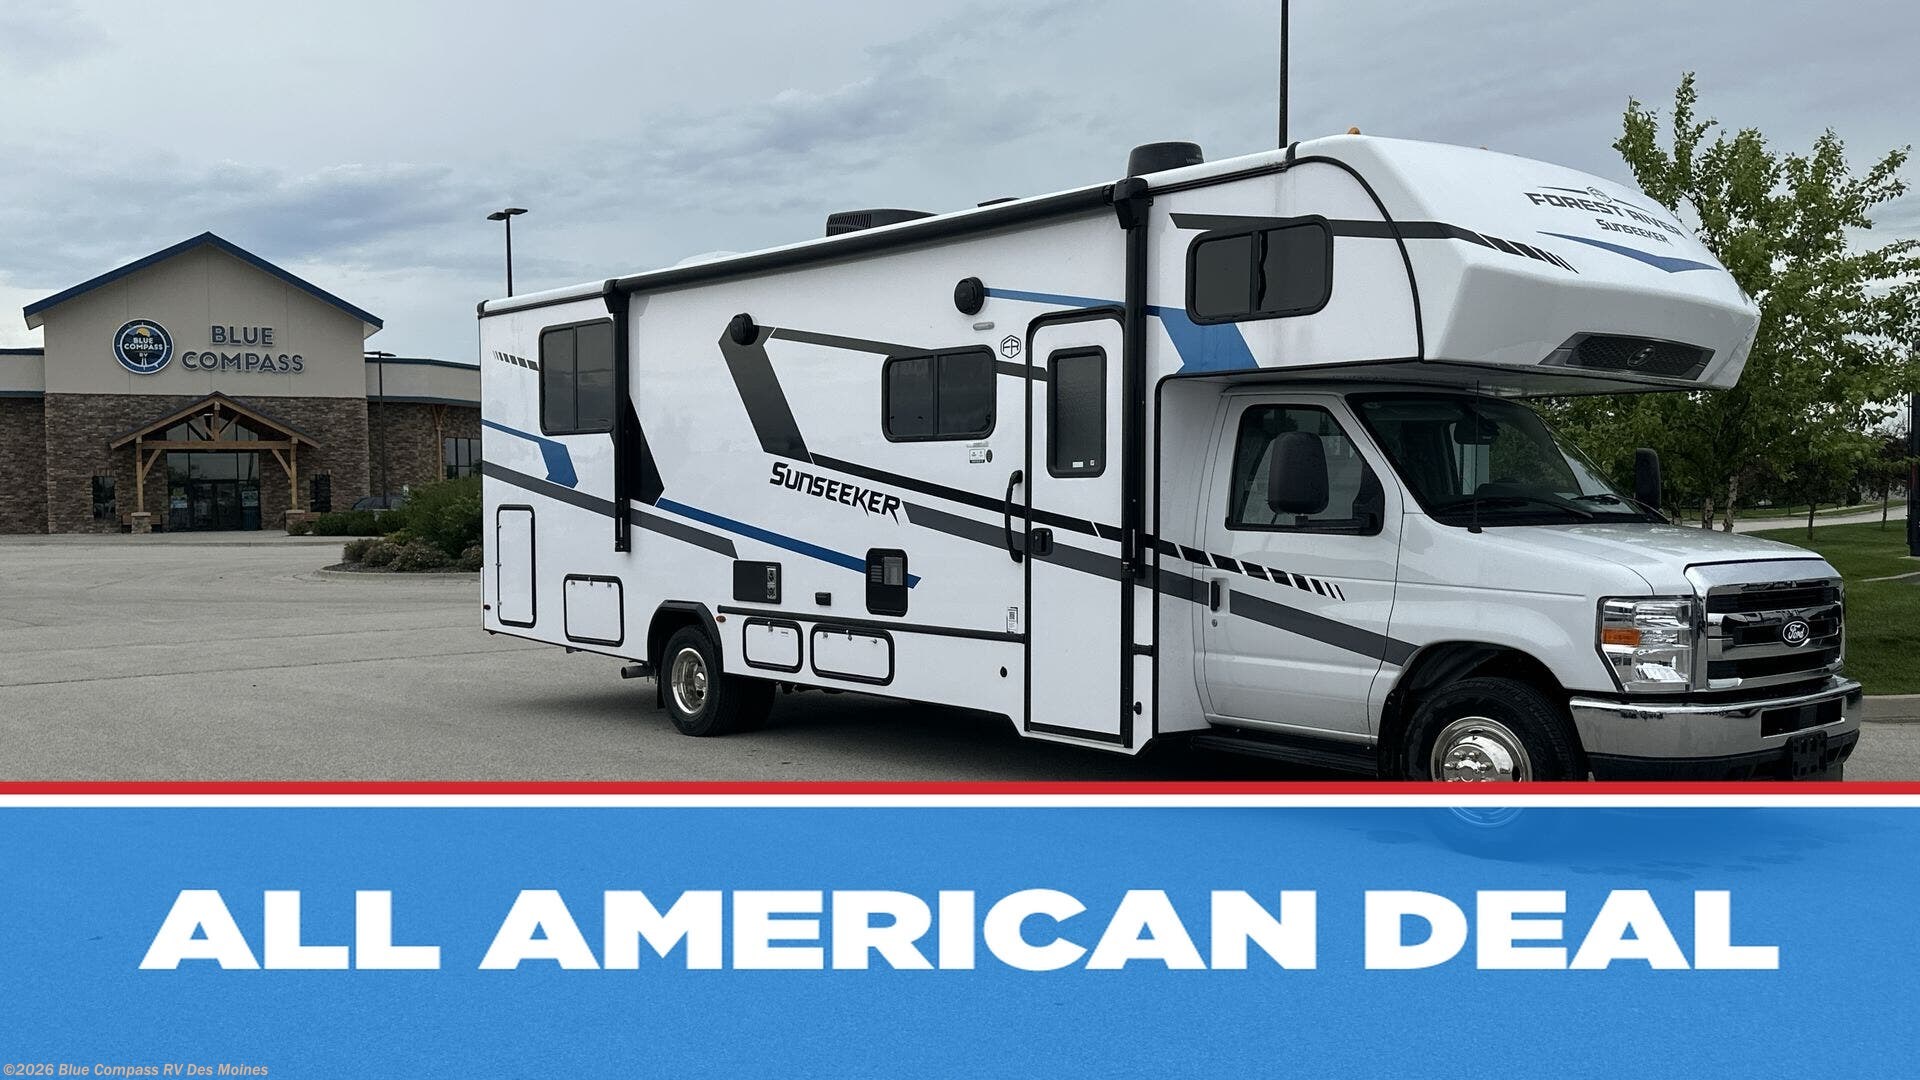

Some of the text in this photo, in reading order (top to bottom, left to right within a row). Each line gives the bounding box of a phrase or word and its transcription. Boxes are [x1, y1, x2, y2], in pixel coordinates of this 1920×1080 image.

[1523, 192, 1624, 217] FOREST
[1624, 208, 1688, 240] RIVER
[211, 325, 274, 345] BLUE
[124, 343, 163, 351] COMPASS
[181, 351, 305, 373] COMPASS
[1788, 624, 1805, 640] Ford
